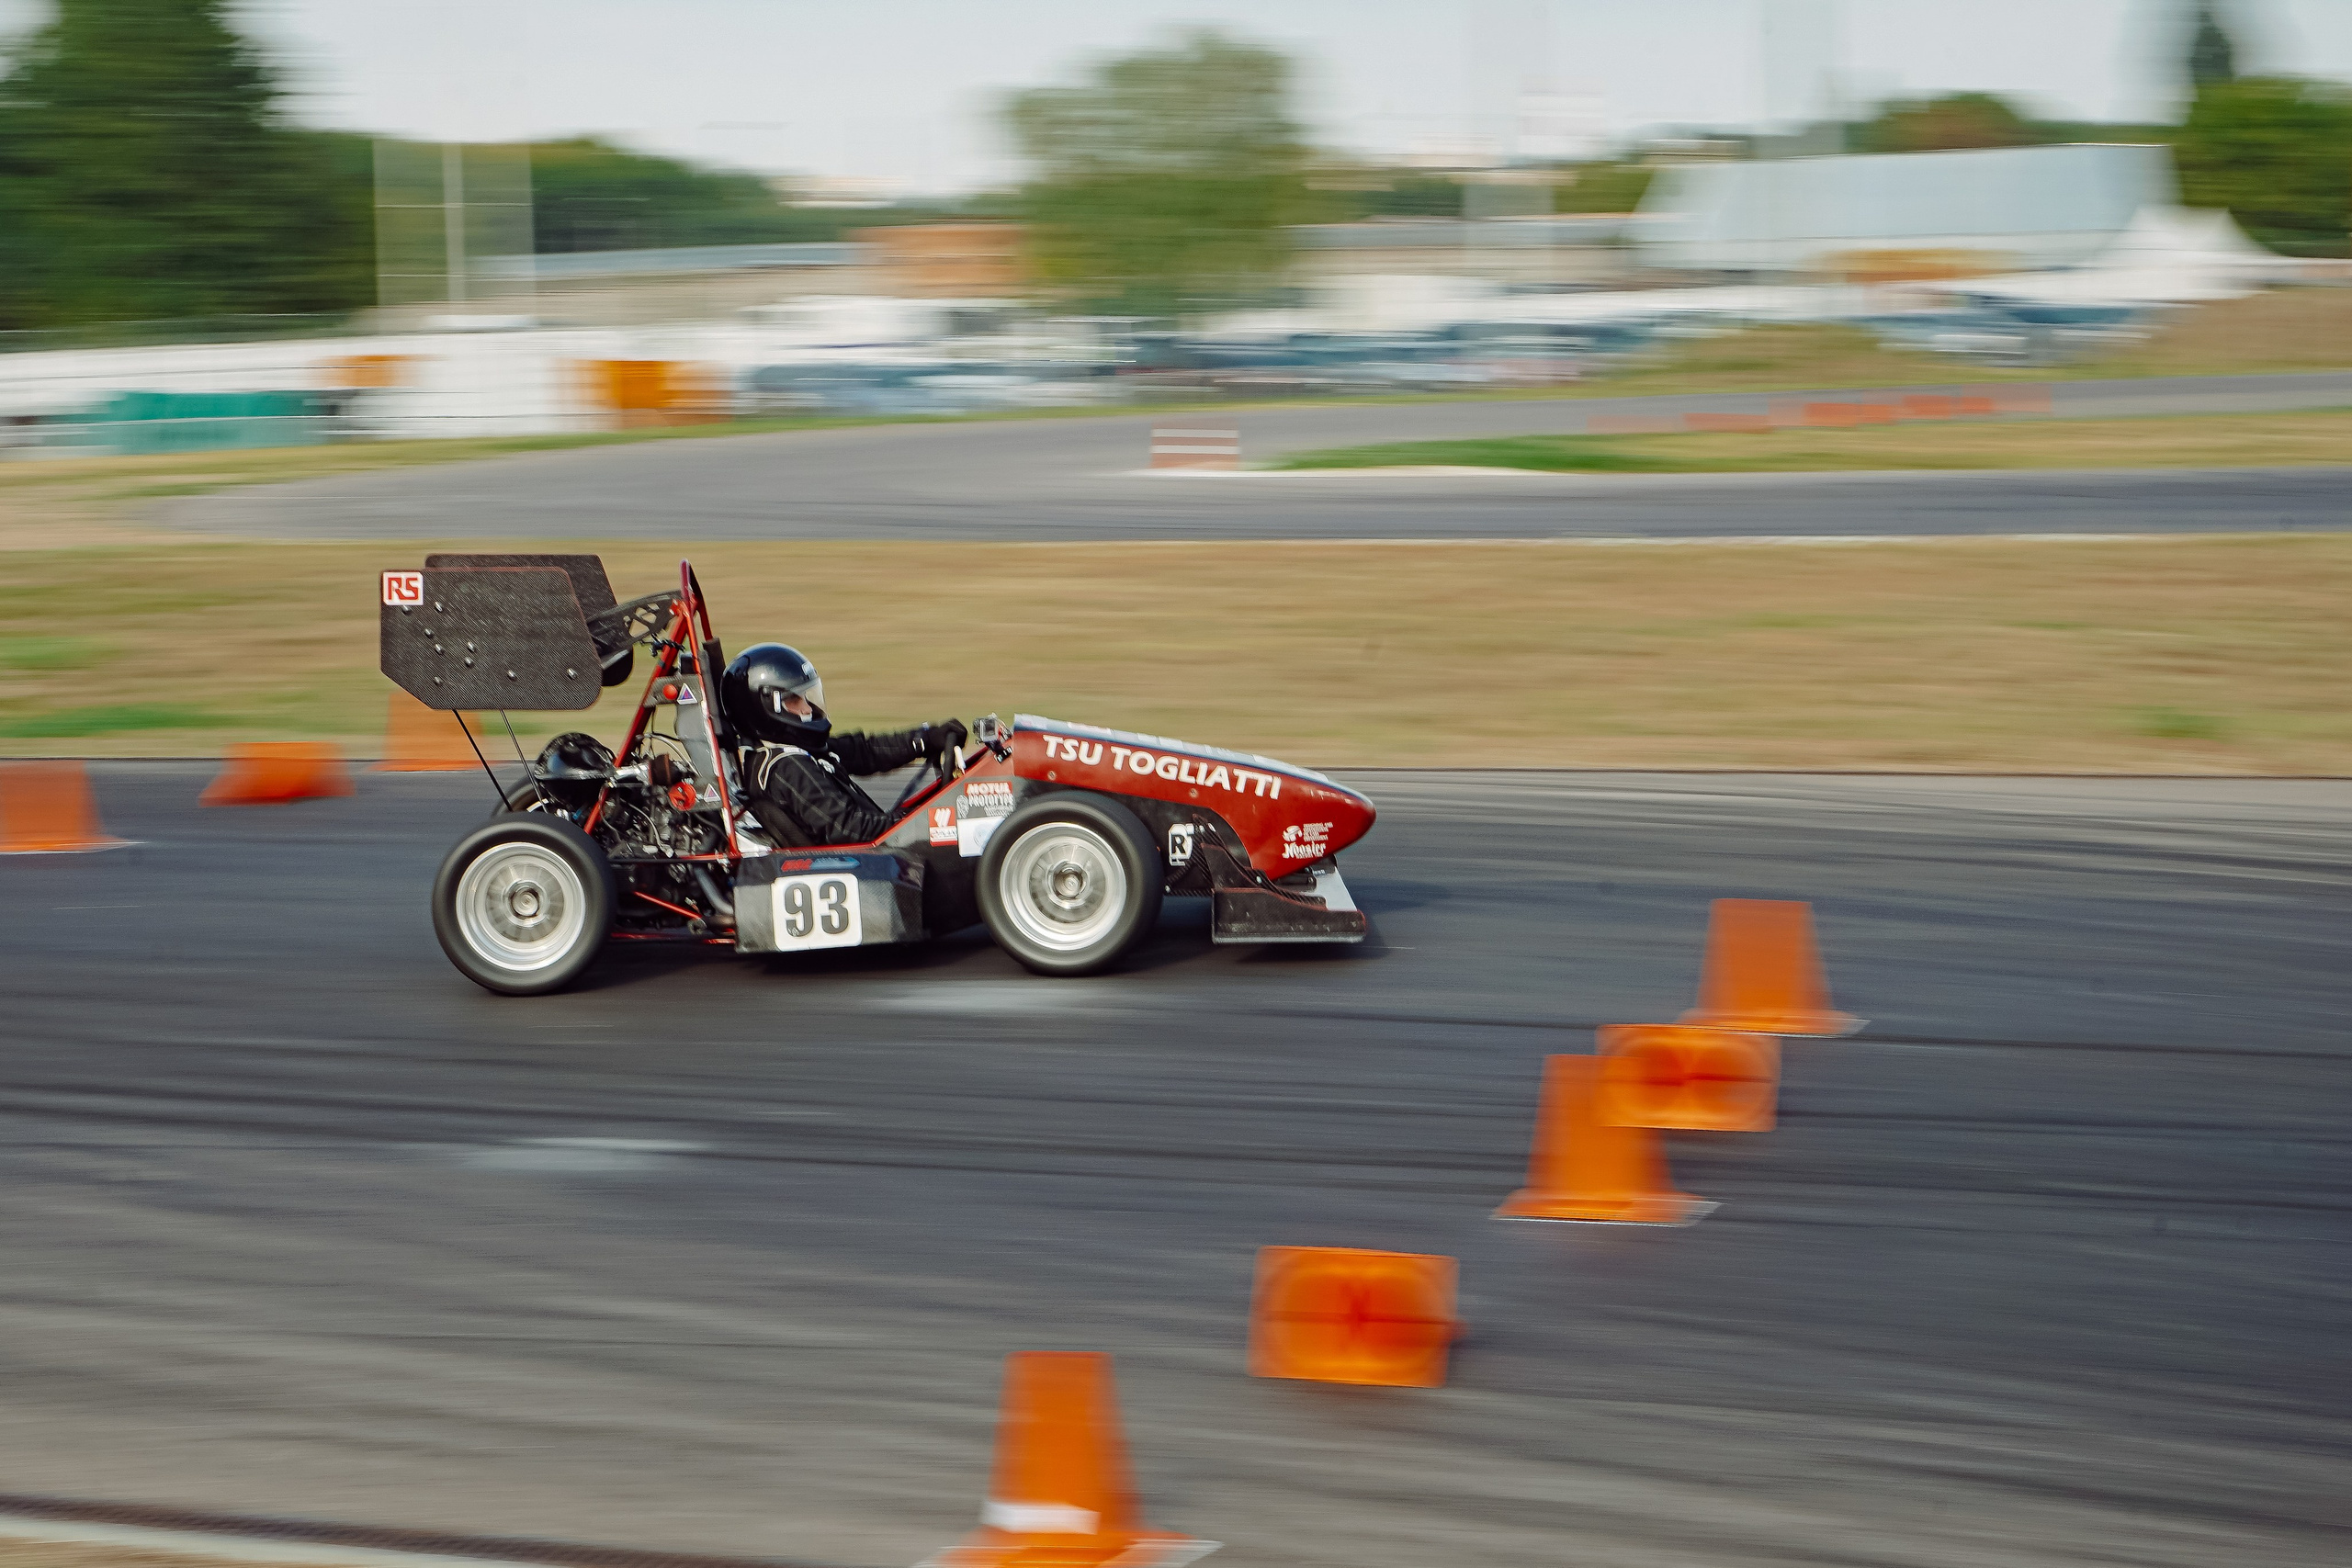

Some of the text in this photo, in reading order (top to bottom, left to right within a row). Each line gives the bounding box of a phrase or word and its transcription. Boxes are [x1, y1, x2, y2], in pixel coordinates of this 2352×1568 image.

[388, 577, 419, 600] RS
[1042, 734, 1283, 800] TSU TOGLIATTI
[784, 880, 849, 937] 93
